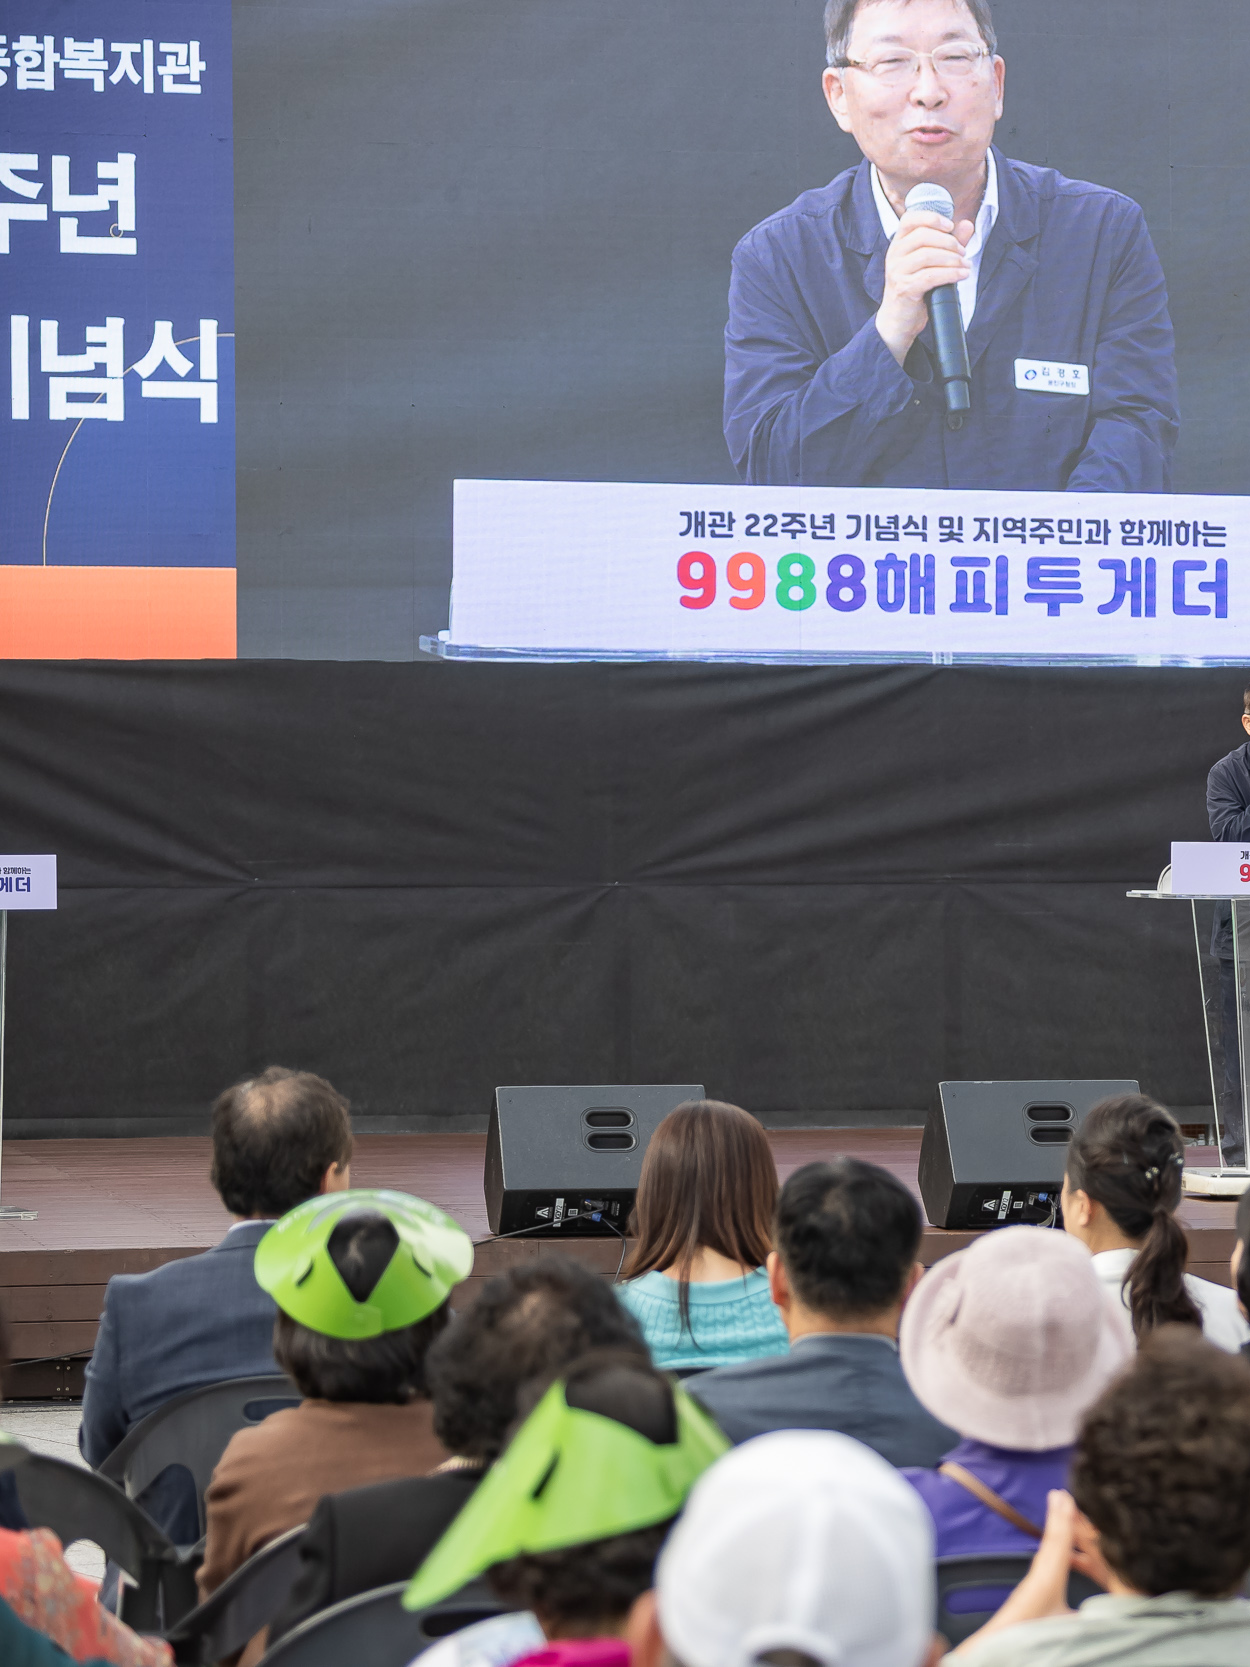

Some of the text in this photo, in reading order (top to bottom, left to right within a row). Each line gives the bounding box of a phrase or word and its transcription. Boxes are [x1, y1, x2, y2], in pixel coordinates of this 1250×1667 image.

[678, 510, 1227, 547] 개관 22주년 기념식 및 지역주민과 함께하는
